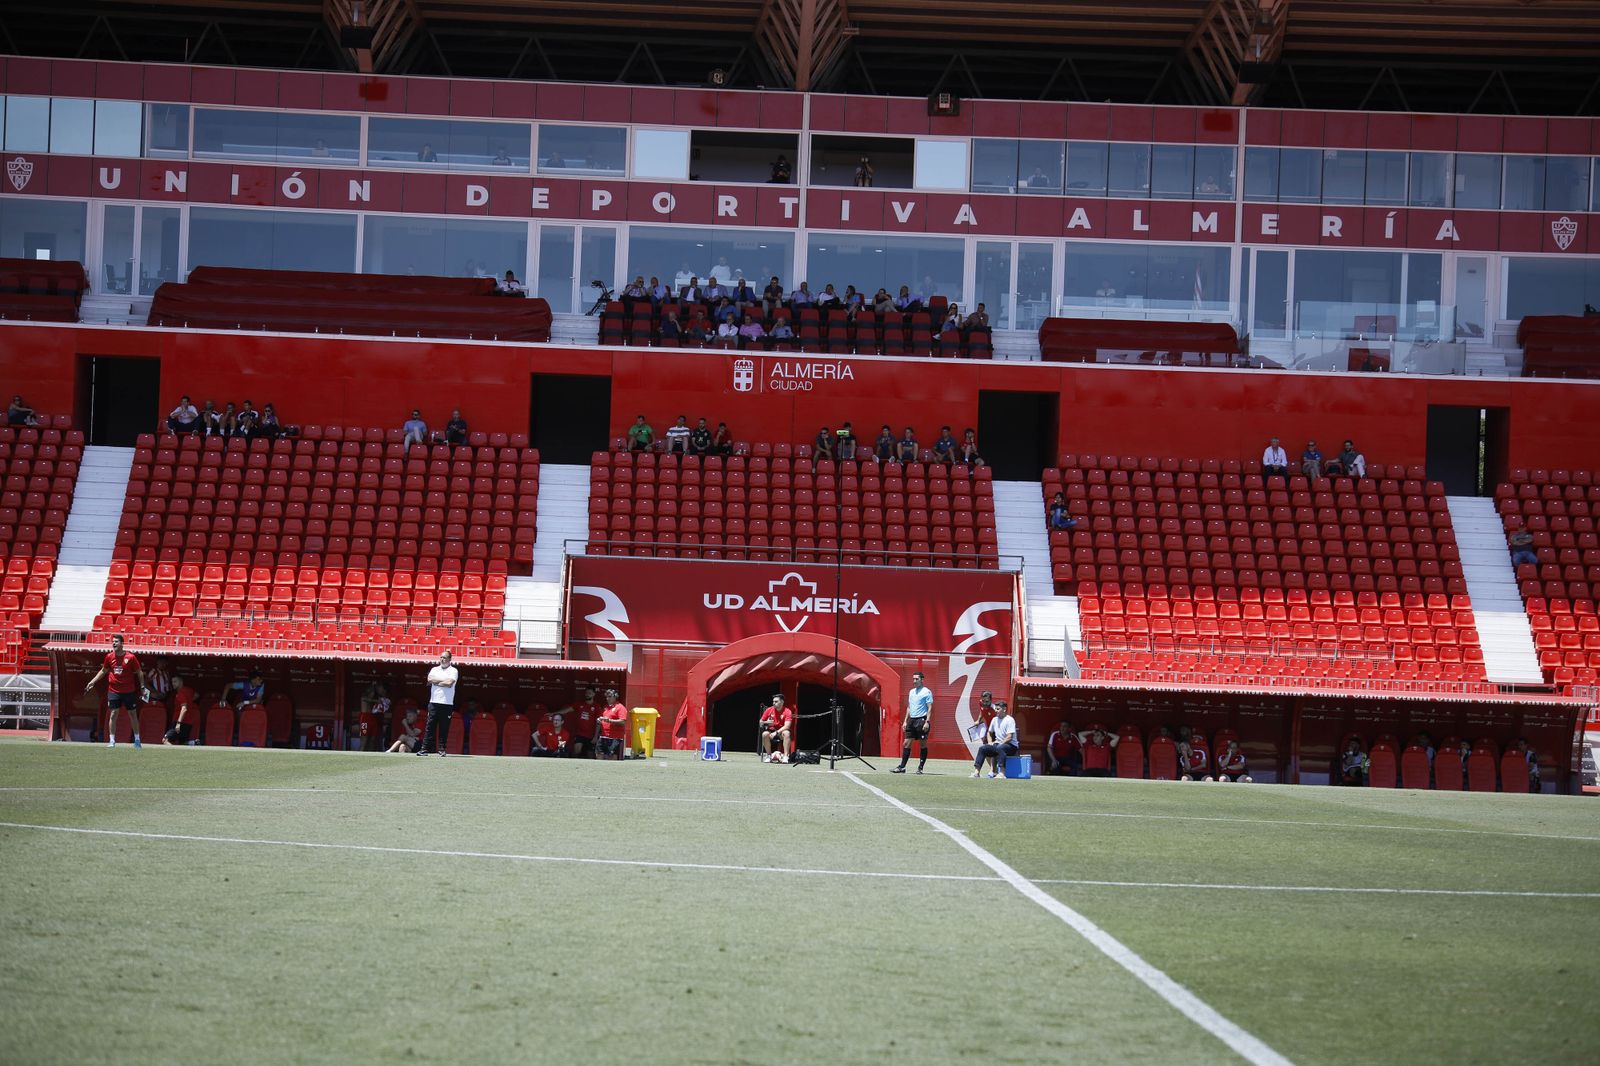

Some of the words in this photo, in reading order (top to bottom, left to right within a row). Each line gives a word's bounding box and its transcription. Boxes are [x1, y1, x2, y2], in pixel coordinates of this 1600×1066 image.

[100, 168, 370, 202] UNIÓN
[467, 185, 977, 225] DEPORTIVA
[1067, 208, 1460, 241] ALMERÍA
[771, 361, 854, 380] ALMERÍA
[770, 380, 813, 391] CIUDAD
[703, 593, 745, 610] UD
[750, 593, 881, 615] ALMERÍA
[315, 725, 324, 738] 9
